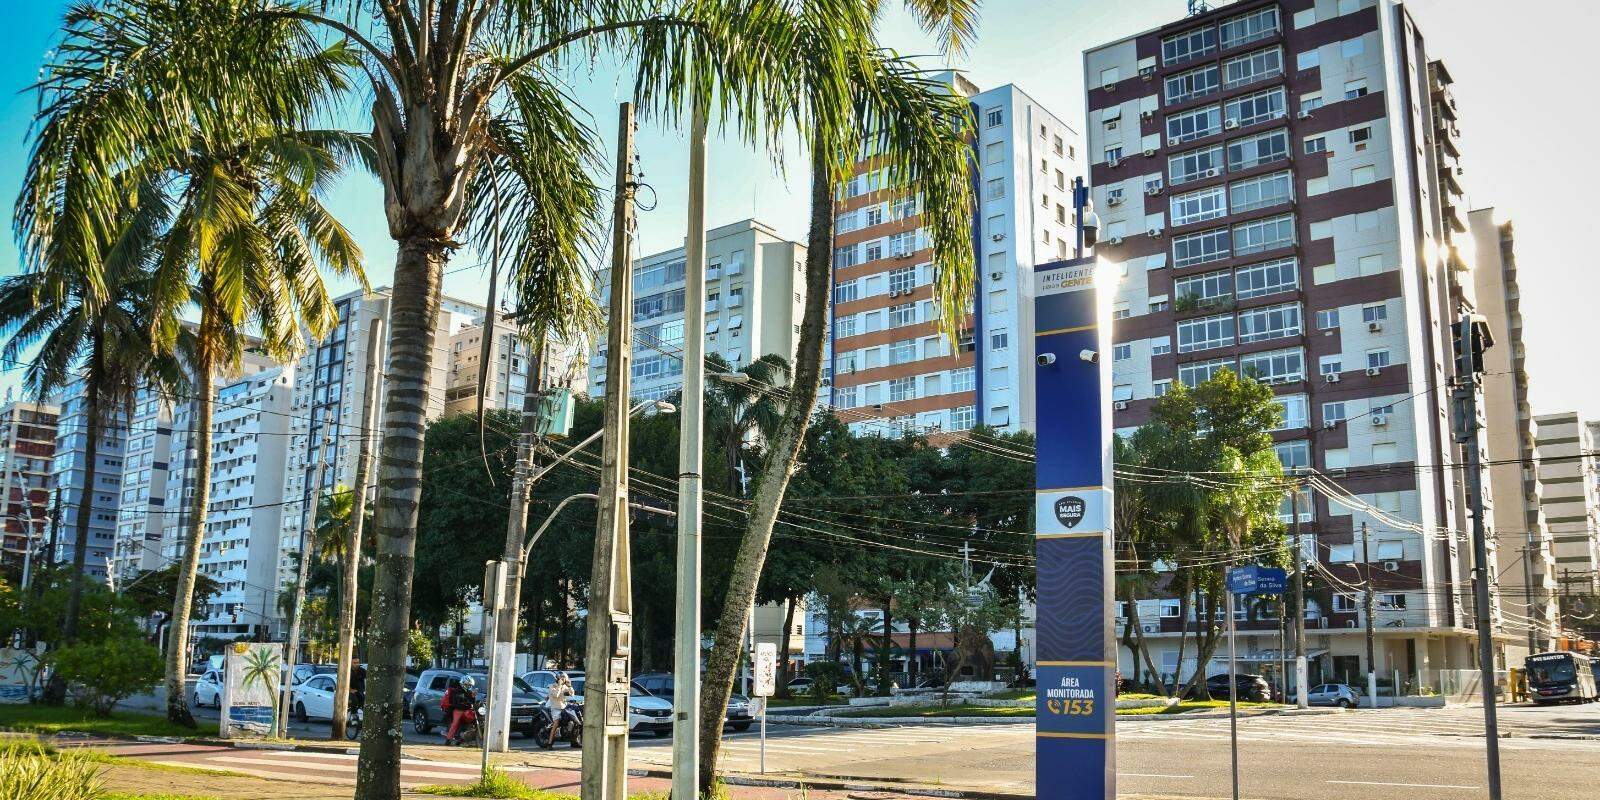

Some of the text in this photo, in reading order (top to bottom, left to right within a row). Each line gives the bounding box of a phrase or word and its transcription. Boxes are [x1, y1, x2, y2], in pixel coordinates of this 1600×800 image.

[1042, 268, 1094, 282] INTELIGENTE
[1061, 277, 1093, 288] GENTE
[1061, 677, 1080, 688] ÁREA
[1047, 689, 1095, 699] MONITORADA
[1064, 700, 1094, 715] 153
